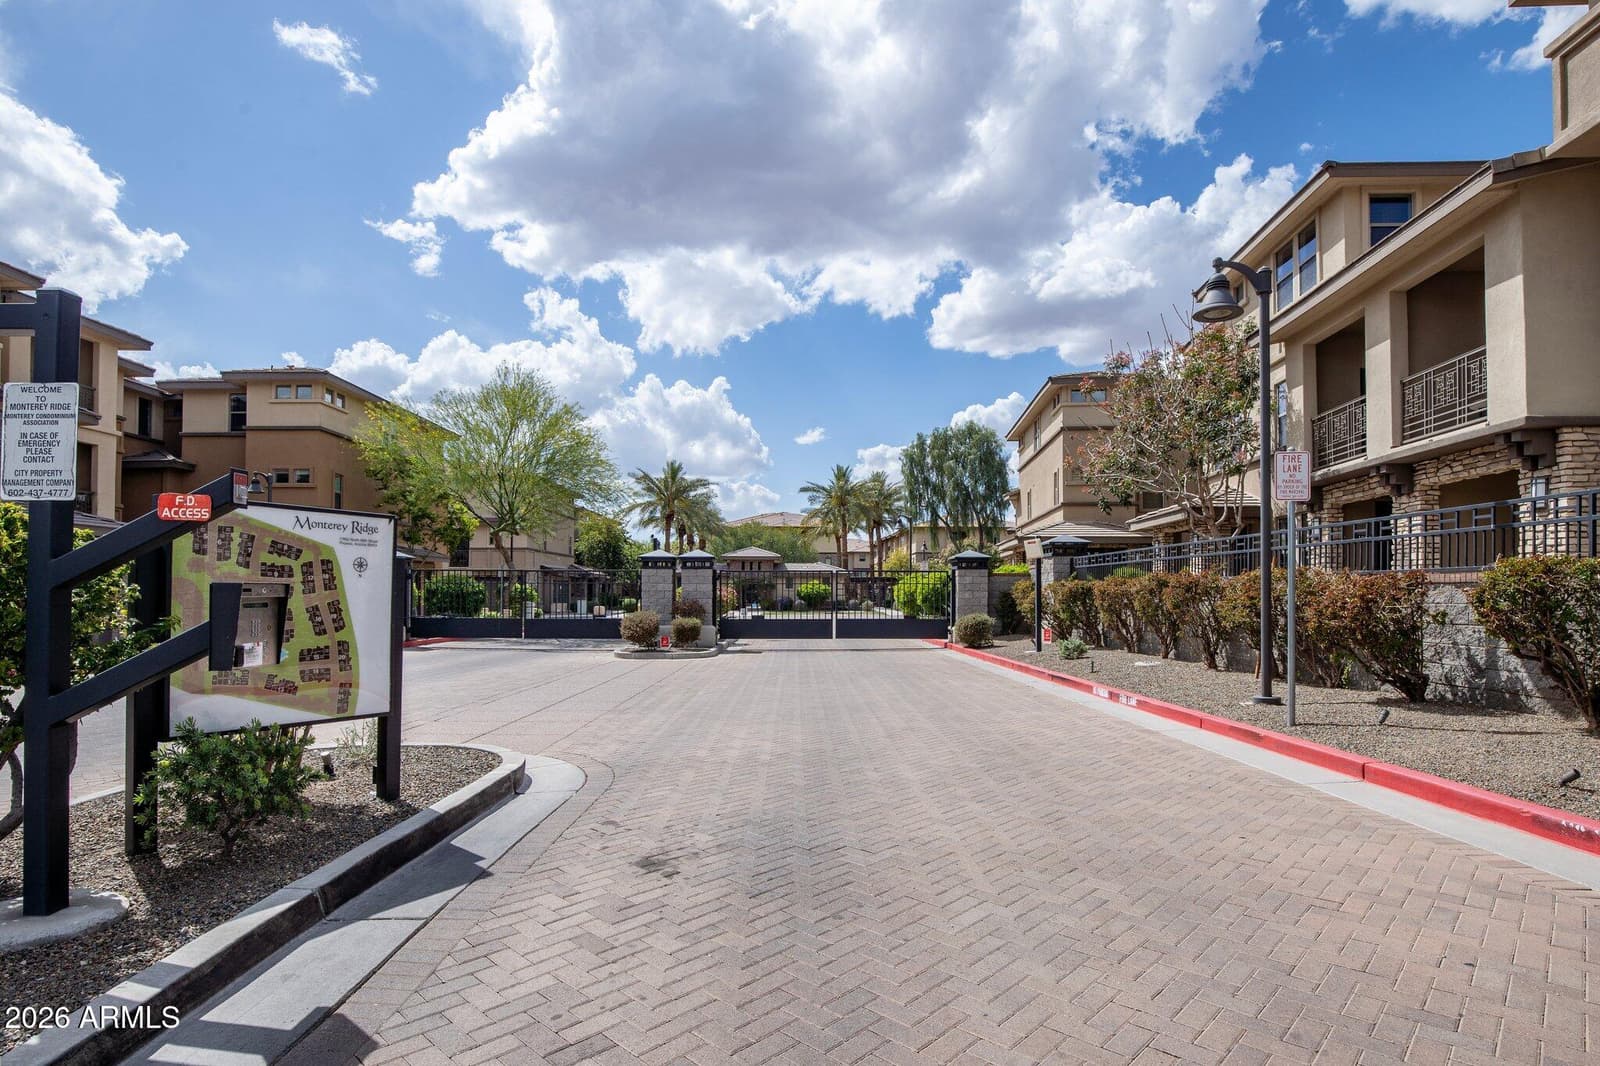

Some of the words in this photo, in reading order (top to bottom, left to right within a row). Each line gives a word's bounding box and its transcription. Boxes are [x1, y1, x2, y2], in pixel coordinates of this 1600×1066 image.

[20, 386, 62, 394] WELCOME
[35, 395, 47, 403] TO
[9, 403, 48, 411] MONTEREY
[50, 403, 72, 411] RIDGE
[20, 432, 28, 440] IN
[29, 432, 48, 440] CASE
[49, 432, 59, 440] OF
[1282, 455, 1302, 463] FIRE
[1282, 464, 1302, 473] LANE
[14, 469, 28, 477] CITY
[30, 469, 63, 477] PROPERTY
[2, 479, 44, 487] MANAGEMENT
[7, 489, 69, 497] 602-437-4777
[175, 495, 198, 506] F.D.
[161, 507, 209, 518] ACCESS
[292, 515, 348, 532] Monterey
[351, 520, 379, 535] Ridge
